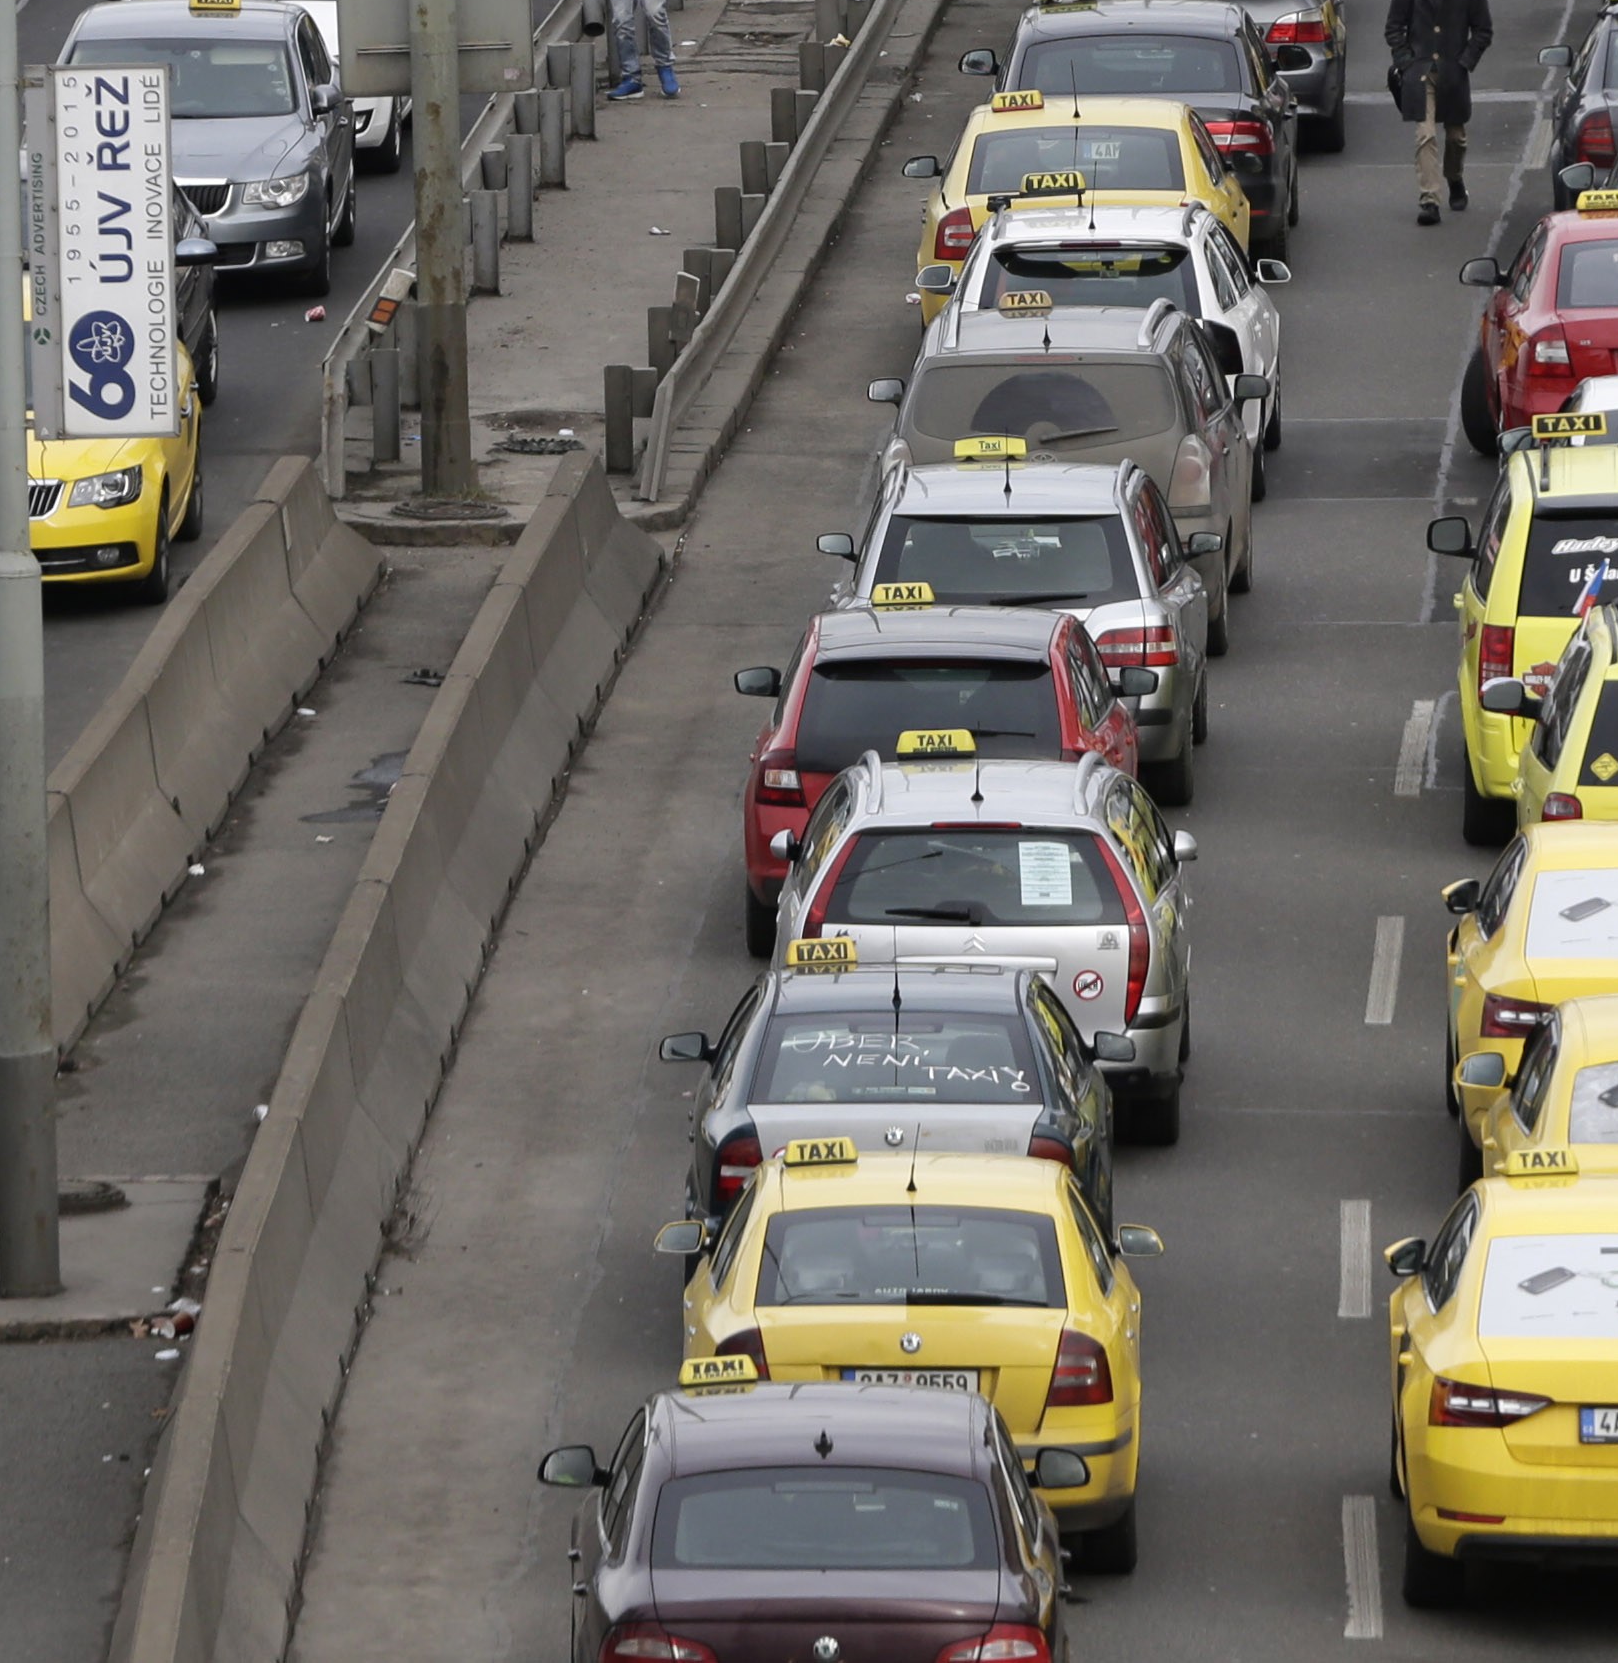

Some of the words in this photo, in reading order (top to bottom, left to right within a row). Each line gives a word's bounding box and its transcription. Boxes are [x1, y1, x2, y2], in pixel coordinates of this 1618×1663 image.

[139, 74, 161, 123] LIDÉ
[1000, 93, 1034, 107] TAXI
[84, 76, 131, 172] ŘEŽ
[1029, 173, 1074, 189] TAXI
[145, 143, 164, 240] INOVACE
[32, 152, 45, 255] ADVERTISING
[89, 191, 134, 284] ÚJV
[35, 264, 47, 316] CZECH
[1007, 292, 1043, 305] TAXI
[147, 260, 168, 420] TECHNOLOGIE
[1545, 416, 1596, 431] TAXI
[978, 440, 1001, 451] Taxi
[1569, 568, 1581, 581] U
[882, 586, 922, 599] TAXI
[917, 734, 953, 747] TAXI
[800, 944, 847, 959] TAXI
[797, 1144, 845, 1160] TAXI
[1520, 1152, 1567, 1169] TAXI
[693, 1360, 744, 1376] TAXI
[916, 1371, 969, 1391] 9559
